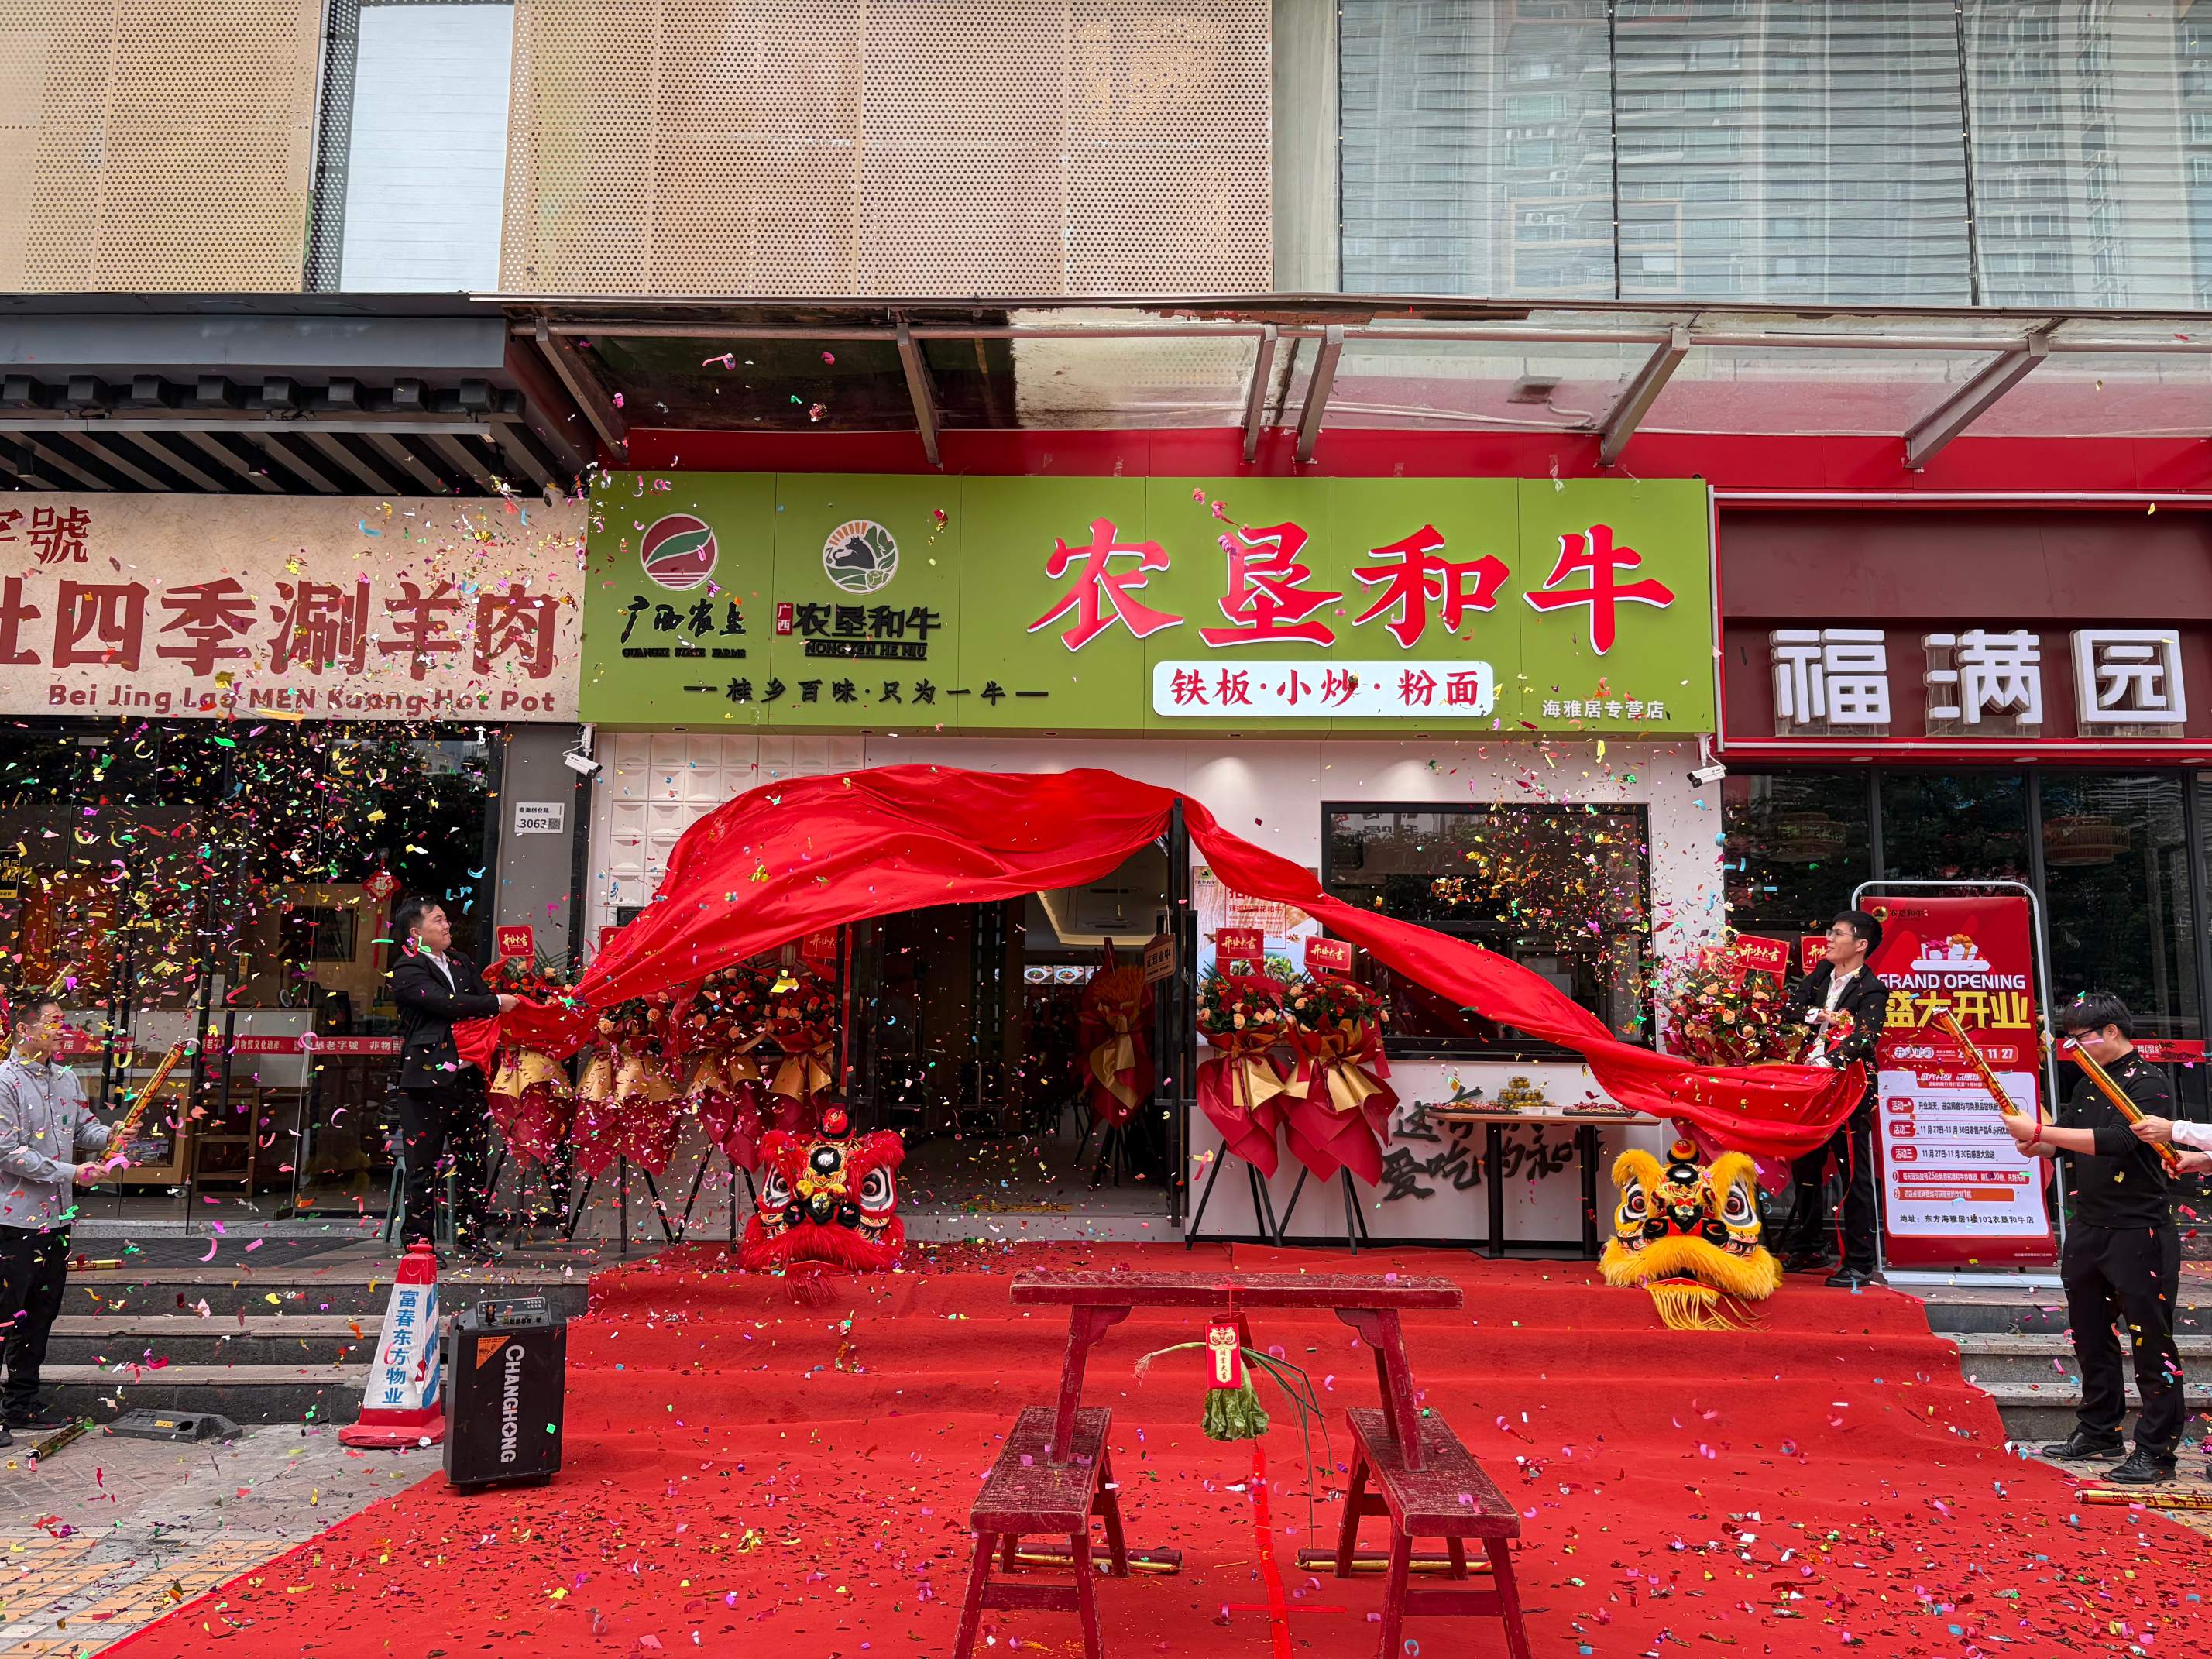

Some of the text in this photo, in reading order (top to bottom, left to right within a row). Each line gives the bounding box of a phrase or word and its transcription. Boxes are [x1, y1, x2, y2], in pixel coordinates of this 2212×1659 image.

[1027, 517, 1674, 655] 农垦和牛
[777, 603, 792, 634] 广西
[795, 603, 941, 640] 农垦和牛
[880, 644, 897, 657] HE
[902, 644, 926, 658] NIU
[1770, 628, 2187, 725] 福满园
[49, 684, 85, 706] Bei
[108, 683, 170, 714] Jing
[249, 687, 316, 709] MEN
[328, 687, 422, 716] Kuang
[435, 689, 489, 711] Hot
[500, 690, 555, 712] Pot
[1542, 699, 1664, 720] 海雅居专营店
[1221, 936, 1257, 953] 开业大吉
[1310, 944, 1345, 960] 开业大吉
[1877, 974, 2026, 989] GRAND OPENING
[1884, 991, 2032, 1029] 盛大开业
[2001, 1049, 2014, 1059] 27
[382, 1290, 419, 1404] 富春东方物业
[500, 1345, 525, 1463] CHANGHONG
